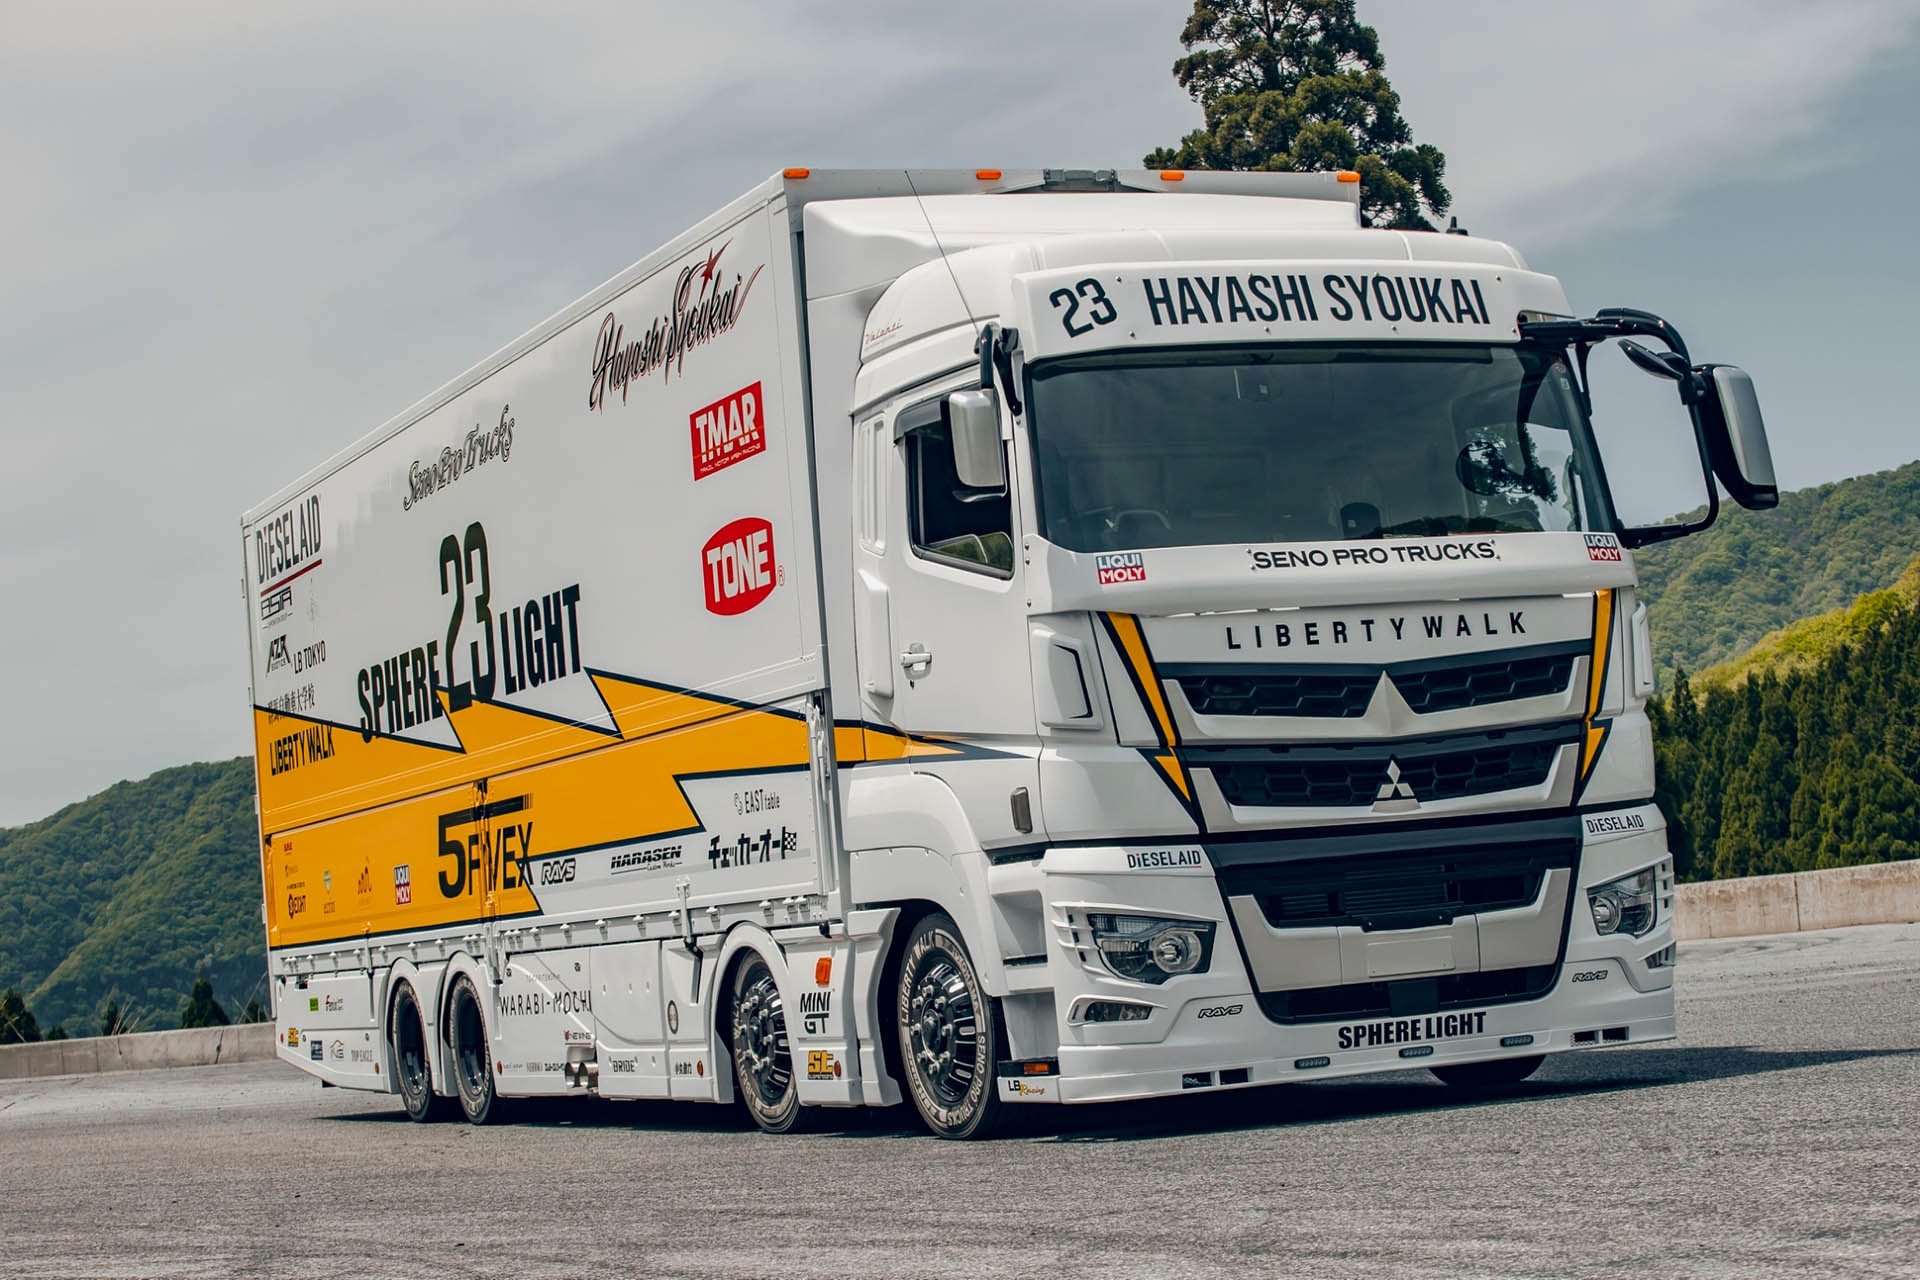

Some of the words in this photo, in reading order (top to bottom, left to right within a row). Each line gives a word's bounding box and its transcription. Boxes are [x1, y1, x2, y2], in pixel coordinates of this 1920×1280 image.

[1049, 278, 1117, 338] 23
[1142, 274, 1319, 326] HAYASHI
[1322, 274, 1491, 325] SYOUKAI
[463, 404, 515, 473] Trucks
[695, 392, 760, 464] TMAR
[1585, 535, 1616, 547] LIQUI
[1589, 548, 1619, 560] MOLY
[706, 528, 771, 603] TONE
[1097, 553, 1142, 569] LIQUI
[1253, 549, 1329, 569] SENO
[1332, 547, 1389, 566] PRO
[1391, 542, 1495, 563] TRUCKS
[1099, 567, 1144, 583] MOLY
[358, 640, 443, 744] SPHERE
[439, 521, 496, 714] 23
[500, 583, 581, 696] LIGHT
[1226, 617, 1405, 650] LIBERTY
[1422, 611, 1527, 638] WALK
[293, 651, 303, 675] LB
[304, 640, 326, 669] TOKYO
[269, 729, 305, 776] LIBERTY
[305, 721, 336, 764] WALK
[745, 788, 764, 813] EAST
[764, 792, 781, 810] table
[611, 845, 682, 869] HARASEN
[541, 857, 577, 885] RAYS
[396, 886, 411, 904] MOLY
[901, 954, 916, 1024] LIBERTY
[913, 930, 935, 960] WALK
[1572, 970, 1608, 983] RAYS
[800, 991, 831, 1013] MINI
[1198, 1005, 1243, 1019] RAYS
[804, 1013, 829, 1034] GT
[1338, 1019, 1421, 1049] SPHERE
[1425, 1011, 1487, 1039] LIGHT
[612, 1060, 635, 1073] BRIDE
[977, 1035, 986, 1074] SENO
[970, 1075, 983, 1102] PRO
[1008, 1080, 1021, 1091] LB
[947, 1099, 974, 1126] TRUCKS
